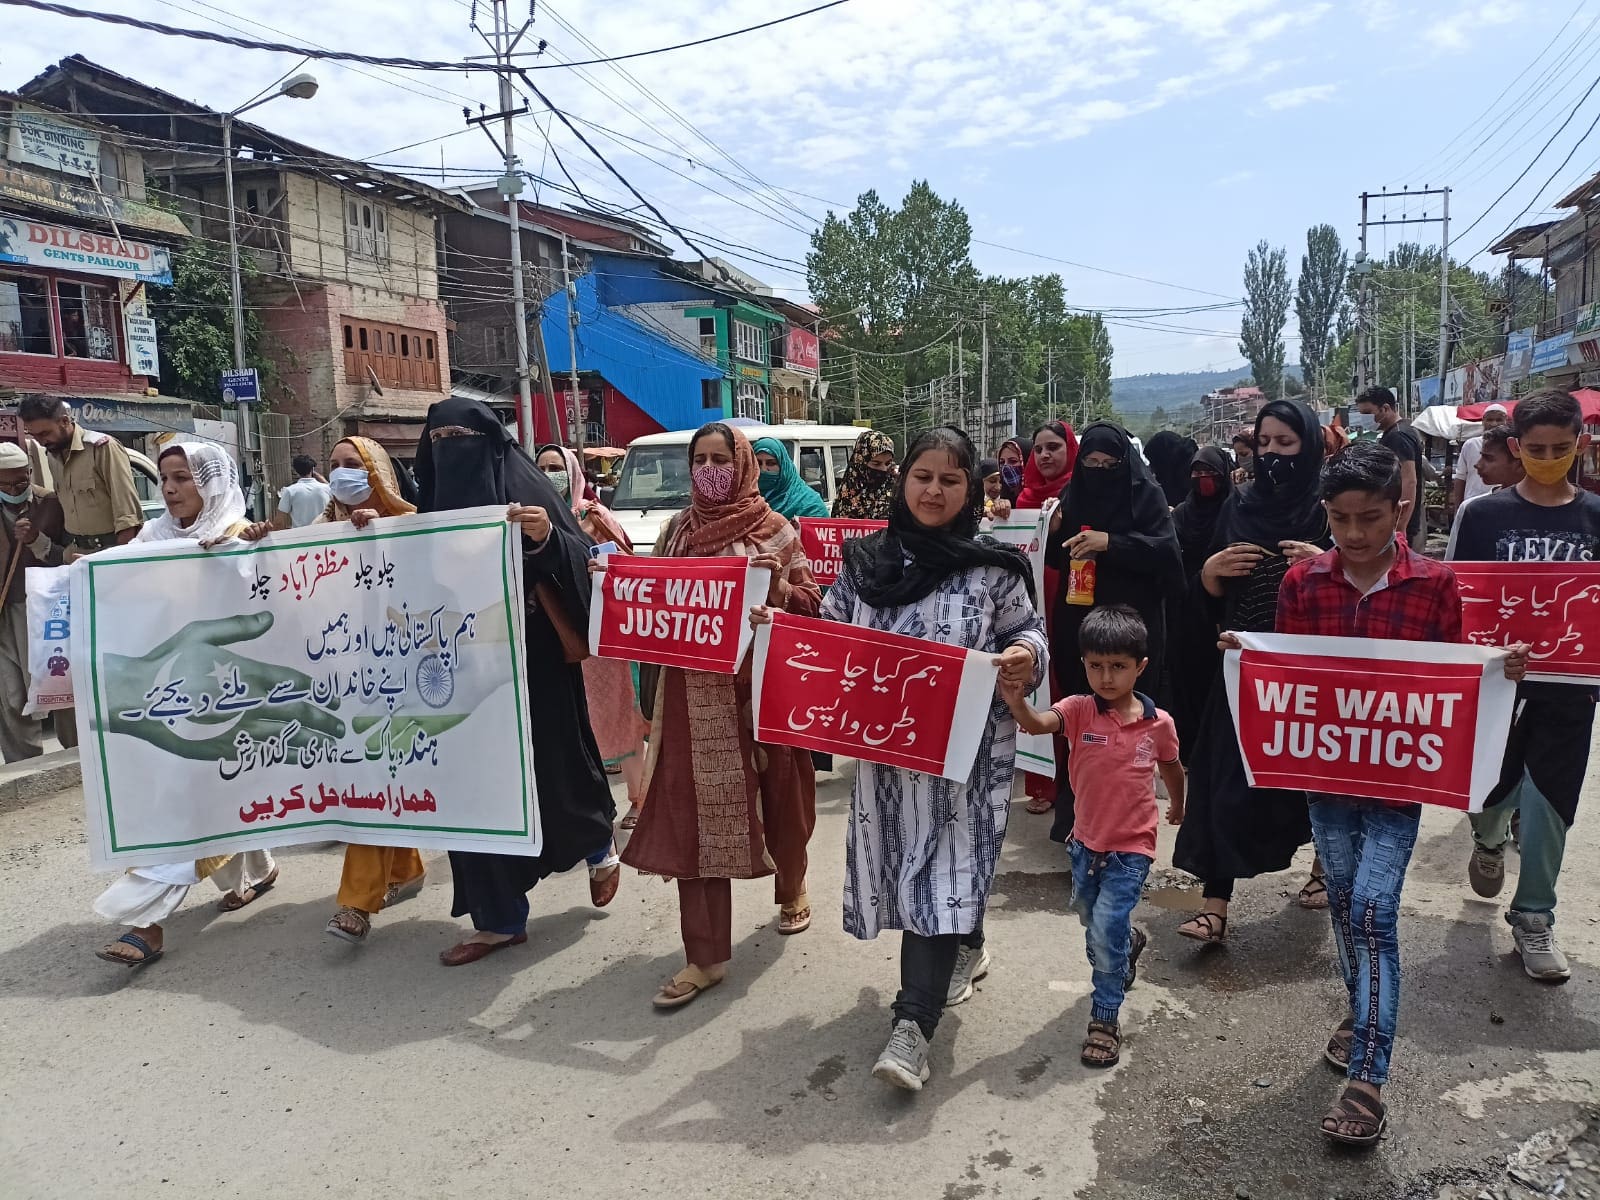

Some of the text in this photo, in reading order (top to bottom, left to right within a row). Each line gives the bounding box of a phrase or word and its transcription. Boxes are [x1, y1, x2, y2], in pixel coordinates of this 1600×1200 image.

[44, 132, 85, 150] BINDING
[27, 223, 149, 260] DILSHAD
[43, 248, 140, 271] GENTS PARLOUR
[222, 368, 253, 377] DILSHAD
[82, 402, 116, 421] One
[815, 527, 879, 542] WE WAN
[823, 543, 843, 558] TR
[249, 564, 271, 601] چلو
[354, 553, 373, 590] چلو
[376, 550, 396, 589] چلو
[613, 577, 737, 610] WE WANT
[306, 602, 475, 666] ہم پاکستانی ہیں اور ہمیں
[619, 607, 724, 646] JUSTICS
[1528, 623, 1584, 659] وطن
[215, 667, 261, 712] ملنے
[268, 680, 308, 704] سے
[312, 667, 376, 704] خاندان
[378, 667, 407, 710] اپنے
[872, 654, 920, 693] کیا
[900, 665, 943, 703] ہم
[787, 697, 917, 746] وطن واپسی
[1254, 678, 1463, 728] WE WANT
[340, 748, 364, 763] سے
[1262, 720, 1444, 772] JUSTICS
[239, 784, 306, 823] کریں
[309, 782, 340, 813] حل
[1369, 996, 1378, 1026] GUCCI
